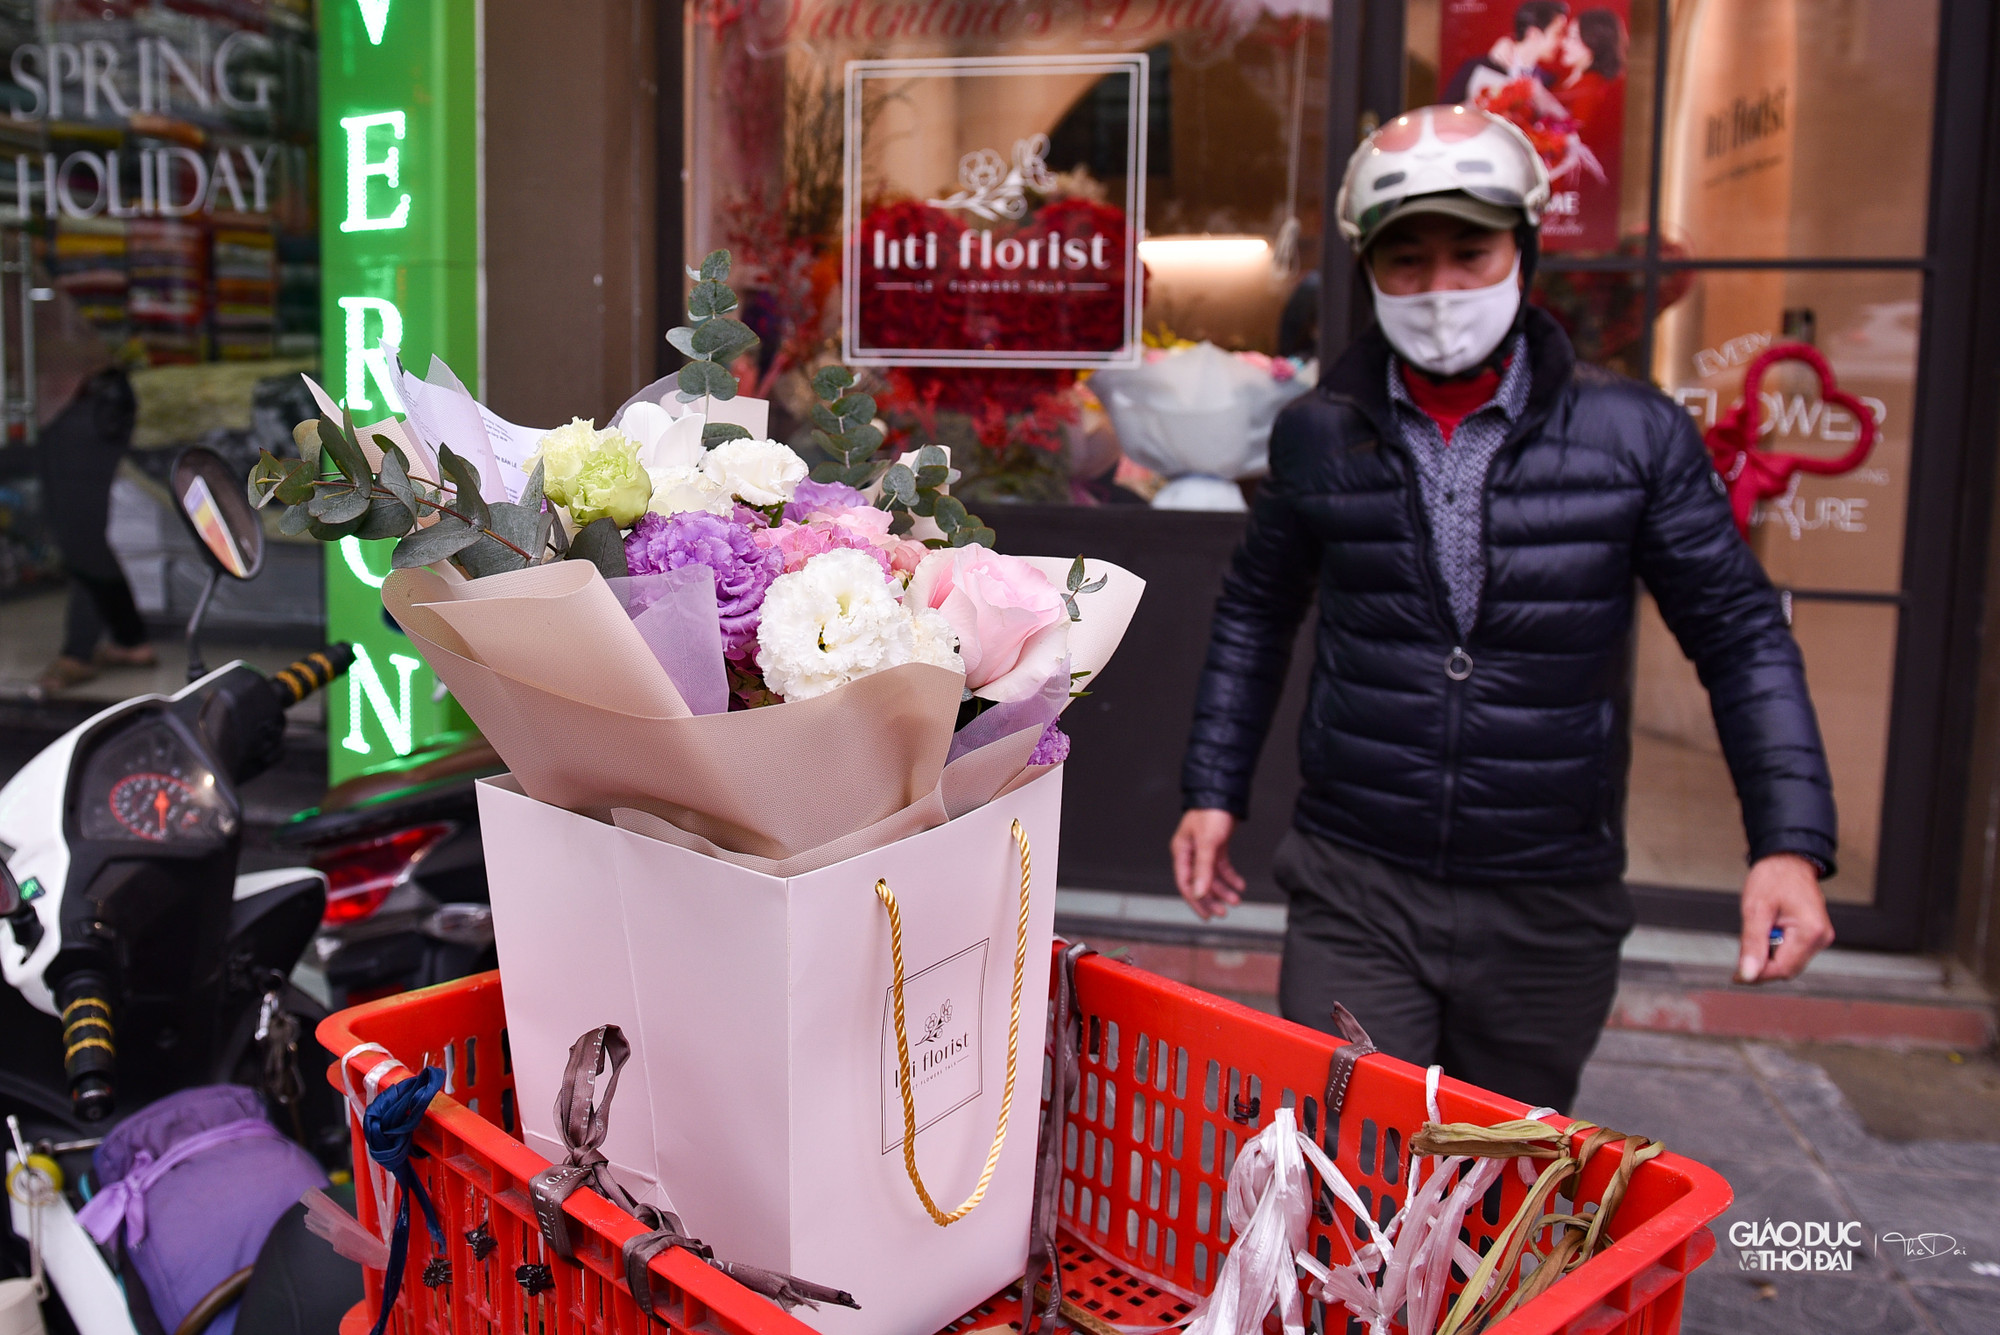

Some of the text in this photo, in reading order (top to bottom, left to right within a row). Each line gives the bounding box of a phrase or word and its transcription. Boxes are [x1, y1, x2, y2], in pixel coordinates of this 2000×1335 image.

[10, 30, 277, 123] SPRING
[16, 145, 279, 220] HOLIDAY
[958, 229, 1111, 270] florist
[339, 0, 422, 756] ERN
[895, 1032, 969, 1089] li florist
